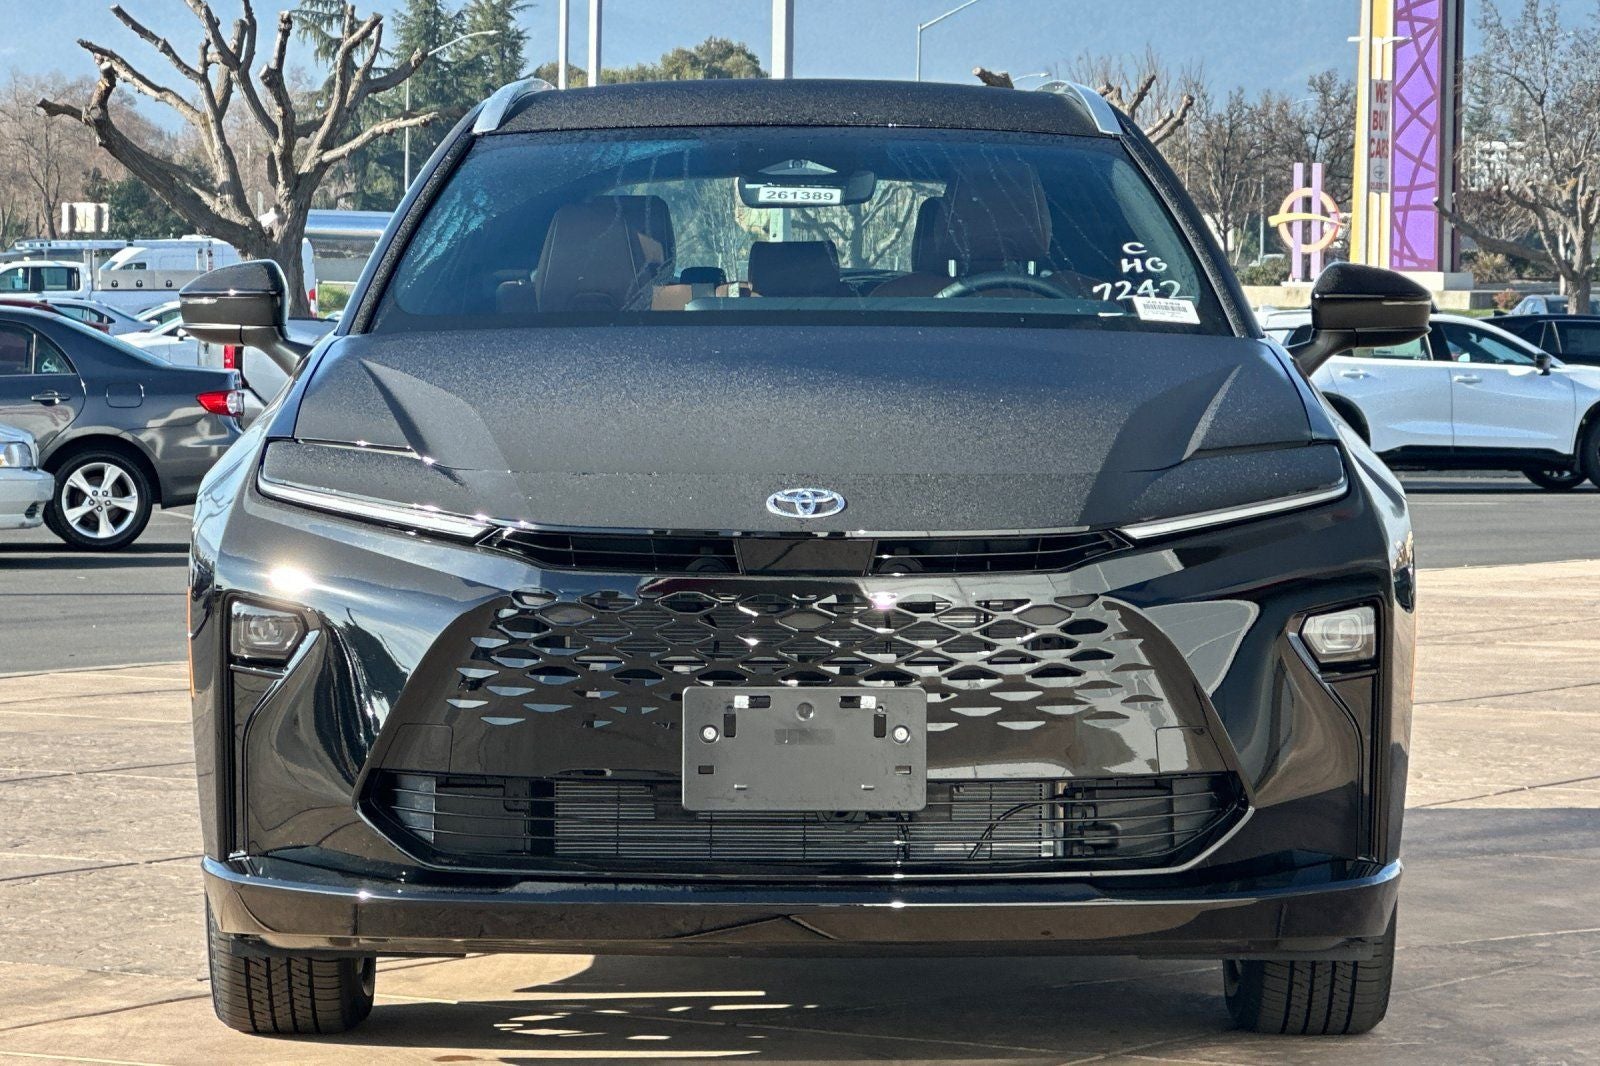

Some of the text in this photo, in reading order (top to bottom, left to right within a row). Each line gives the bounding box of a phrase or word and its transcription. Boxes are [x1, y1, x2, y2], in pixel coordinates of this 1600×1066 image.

[1375, 82, 1388, 103] WE
[1372, 110, 1389, 131] BUY
[1370, 137, 1389, 159] CARS
[766, 190, 834, 201] 261389
[1121, 257, 1168, 273] HG
[1092, 279, 1196, 302] 7242
